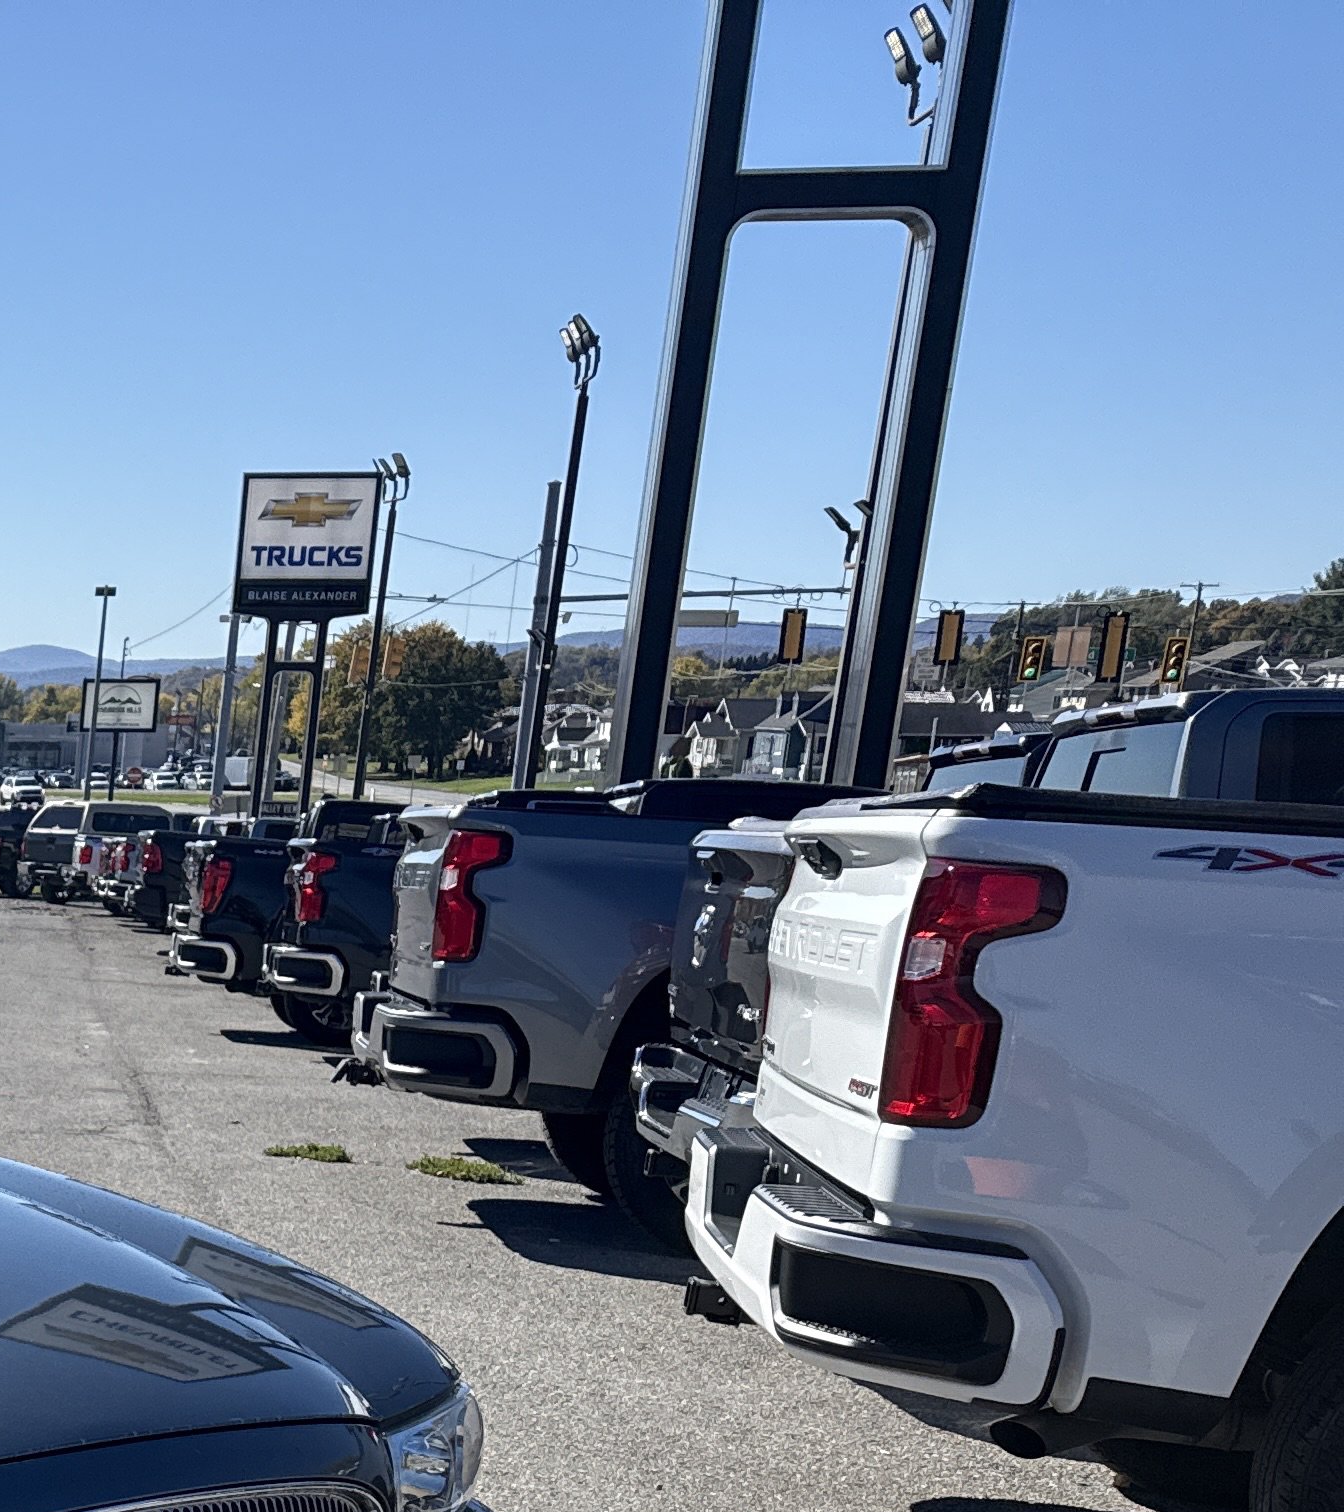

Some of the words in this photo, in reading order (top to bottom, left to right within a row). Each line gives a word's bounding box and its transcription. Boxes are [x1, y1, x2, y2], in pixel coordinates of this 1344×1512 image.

[250, 546, 363, 567] TRUCKS
[247, 590, 287, 601] BLAISE
[291, 591, 358, 601] ALEXANDER
